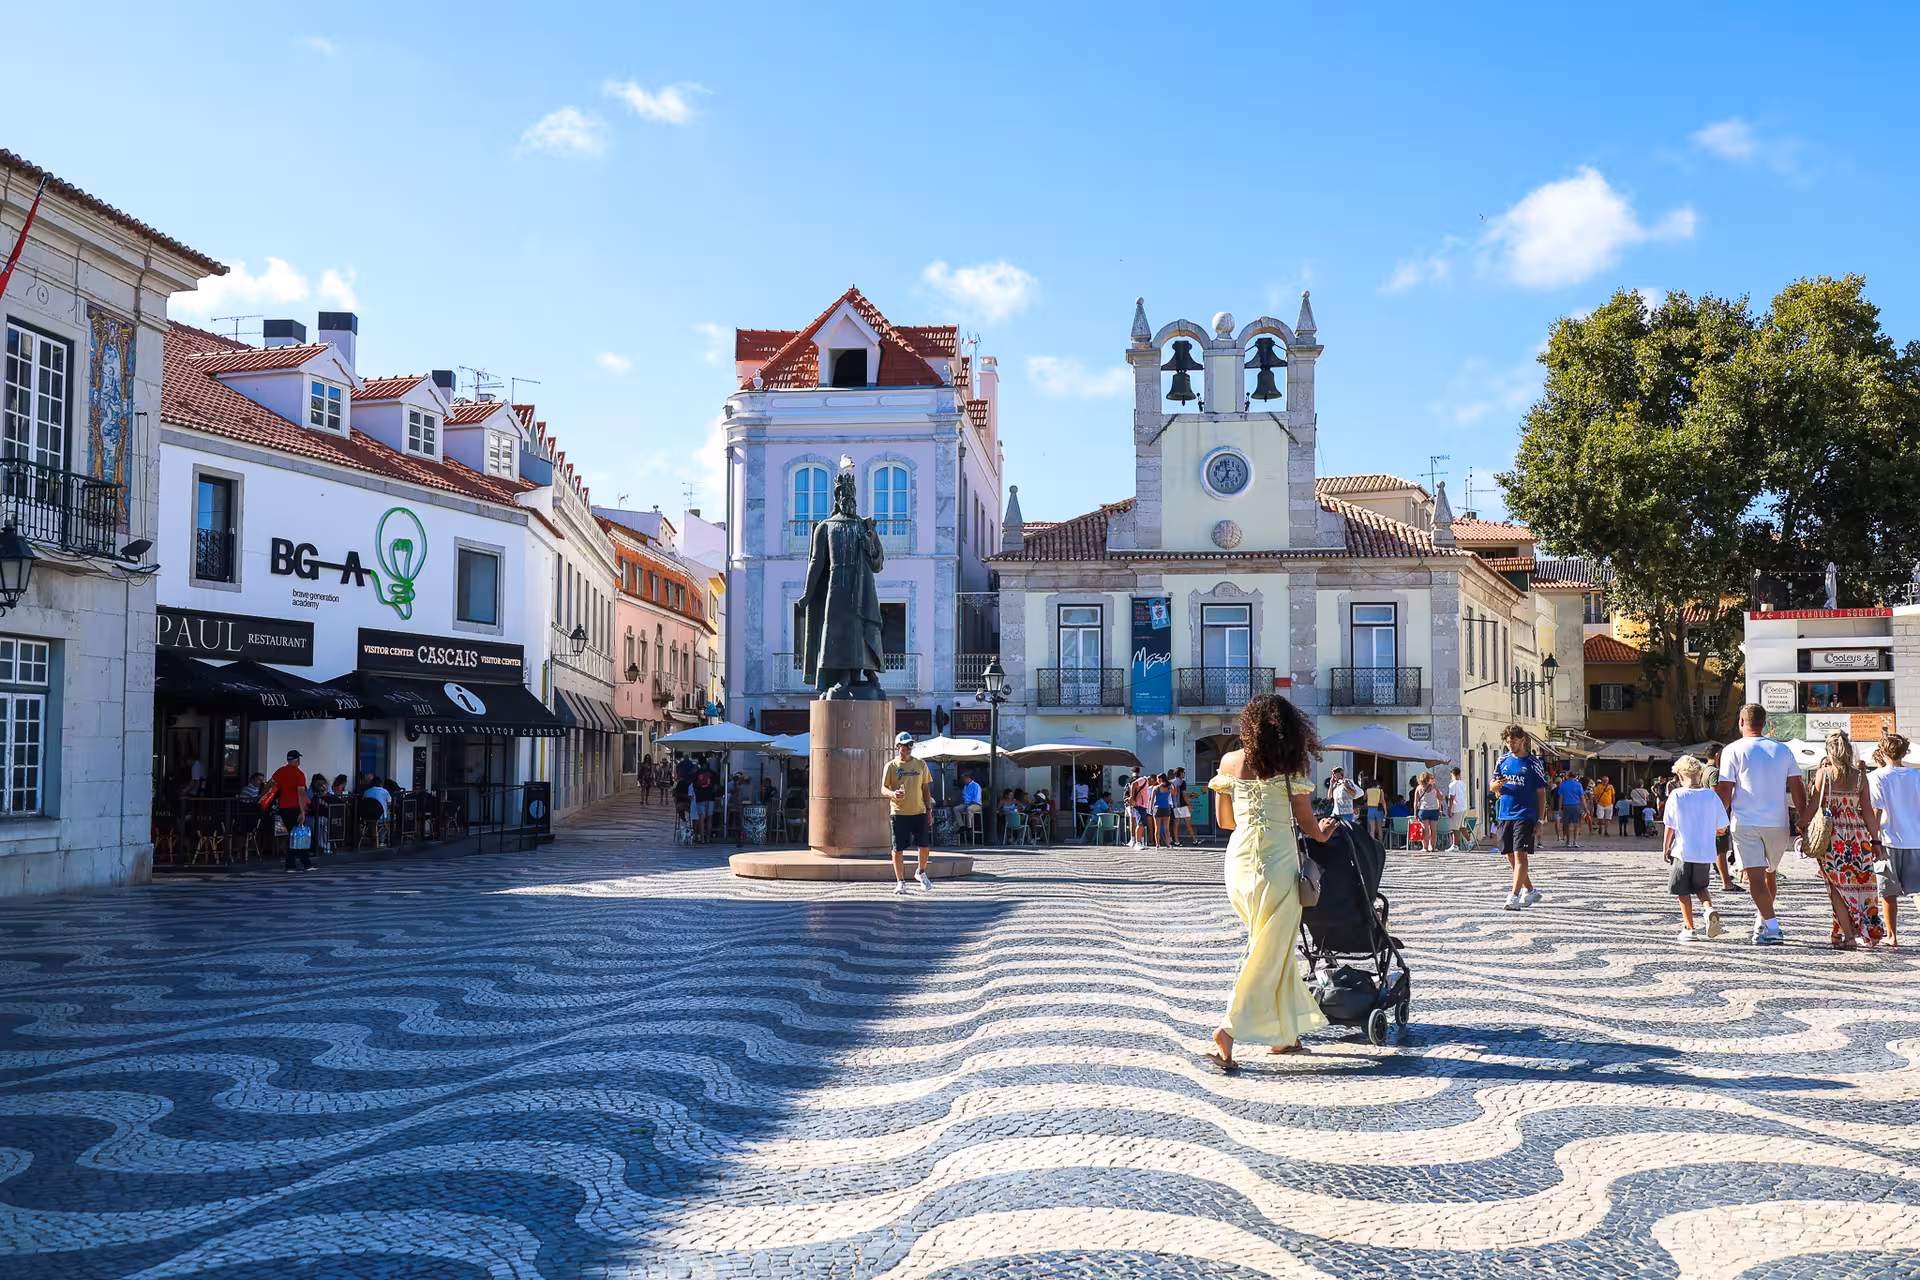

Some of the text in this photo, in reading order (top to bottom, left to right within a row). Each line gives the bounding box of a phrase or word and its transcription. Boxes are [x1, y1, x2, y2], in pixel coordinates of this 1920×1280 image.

[292, 589, 340, 603] brave generation
[292, 599, 320, 610] academy
[1780, 609, 1835, 619] STEAKHOUSE
[1847, 607, 1886, 617] ROOFTOP
[156, 615, 307, 652] PAUL RESTAURANT
[364, 645, 522, 668] VISITOR CENTER CASCAIS VISITOR CENTER
[1823, 652, 1862, 664] Cooleys
[260, 693, 289, 707] PAUL
[335, 698, 364, 710] PAUL
[412, 704, 437, 716] PAUL
[962, 714, 987, 722] IRISH
[414, 724, 562, 736] CASCAIS VISITOR CENTER
[966, 722, 984, 730] PUB
